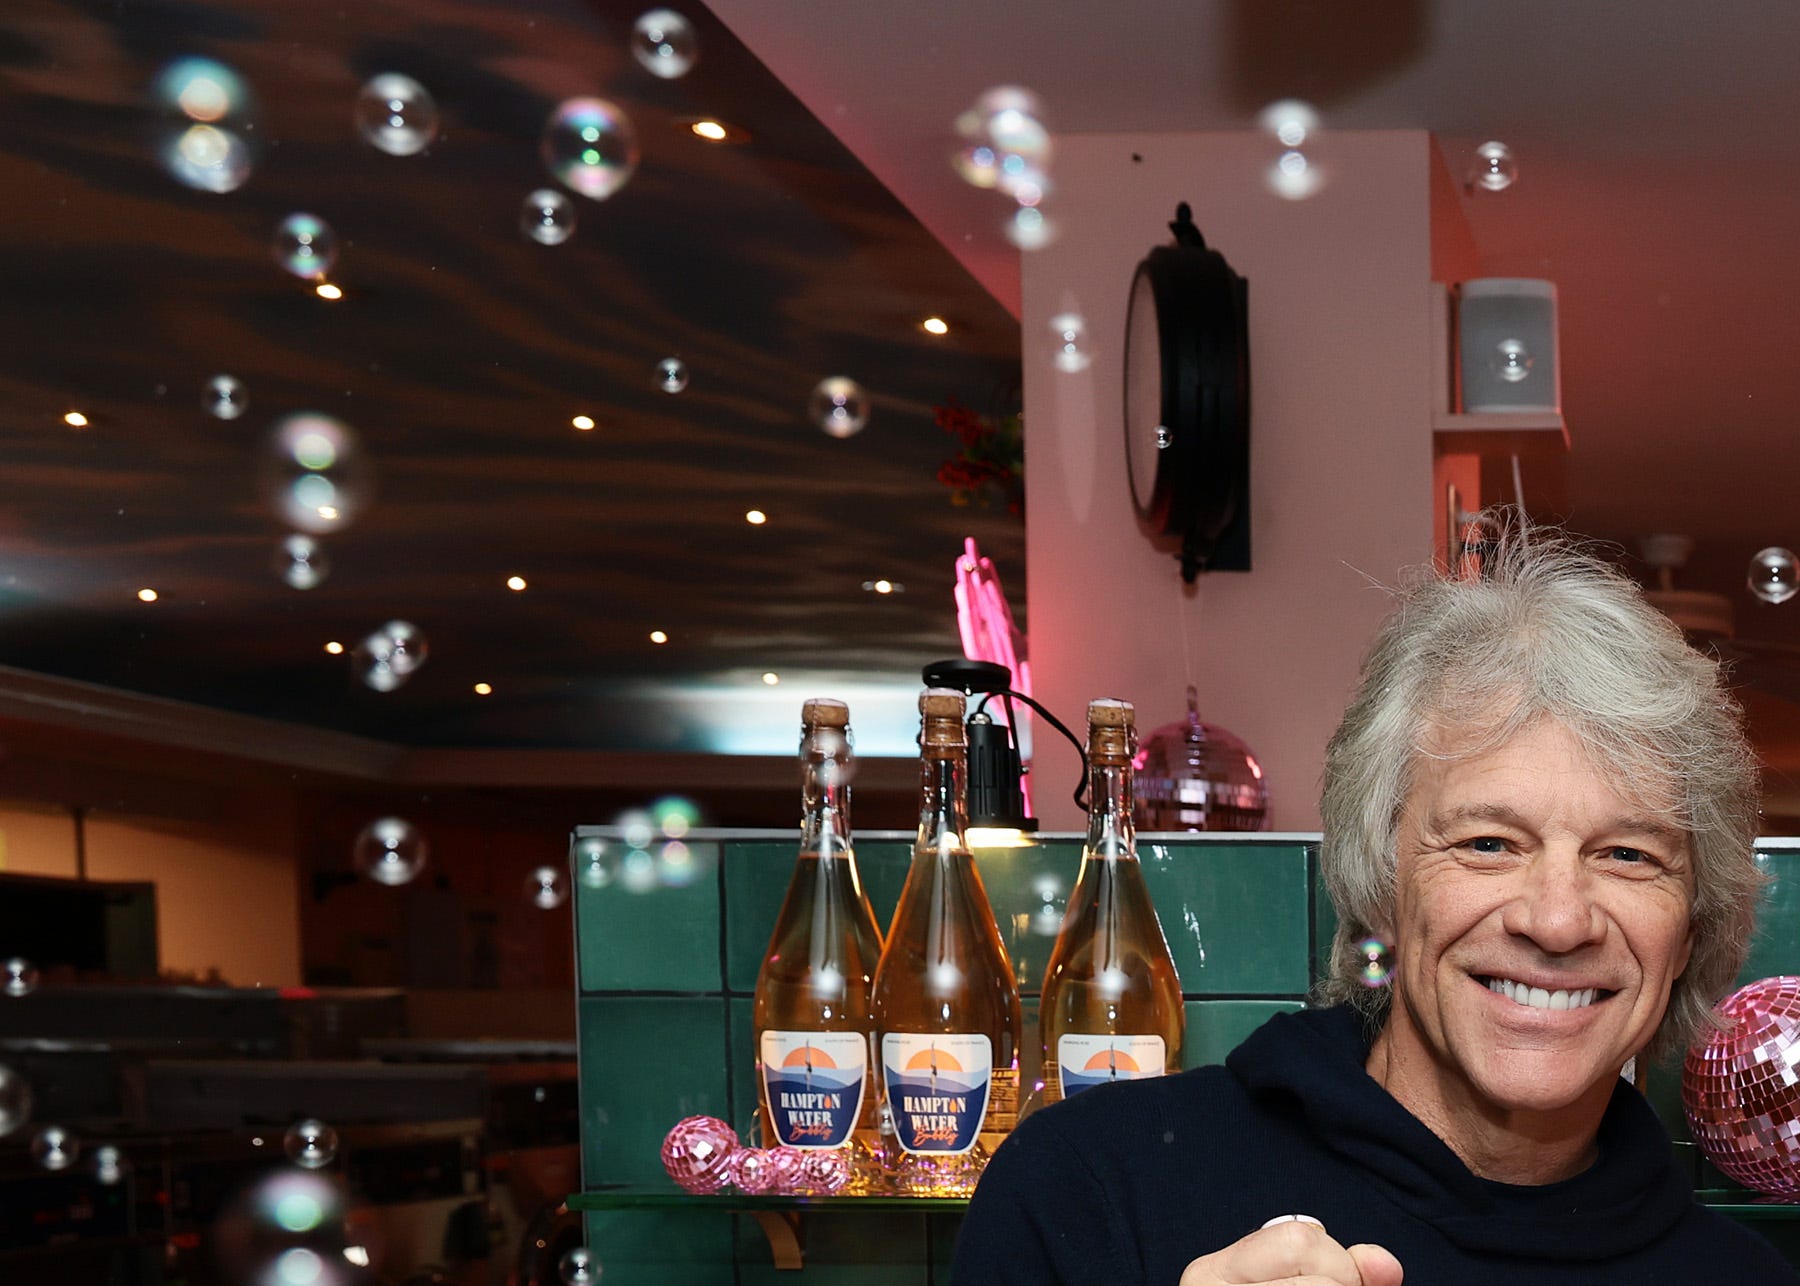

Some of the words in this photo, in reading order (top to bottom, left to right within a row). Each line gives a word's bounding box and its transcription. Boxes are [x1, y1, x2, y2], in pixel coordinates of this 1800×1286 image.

[781, 1092, 841, 1109] HAMPTON
[903, 1096, 966, 1114] HAMPTON
[788, 1110, 833, 1127] WATER
[911, 1114, 959, 1131] WATER
